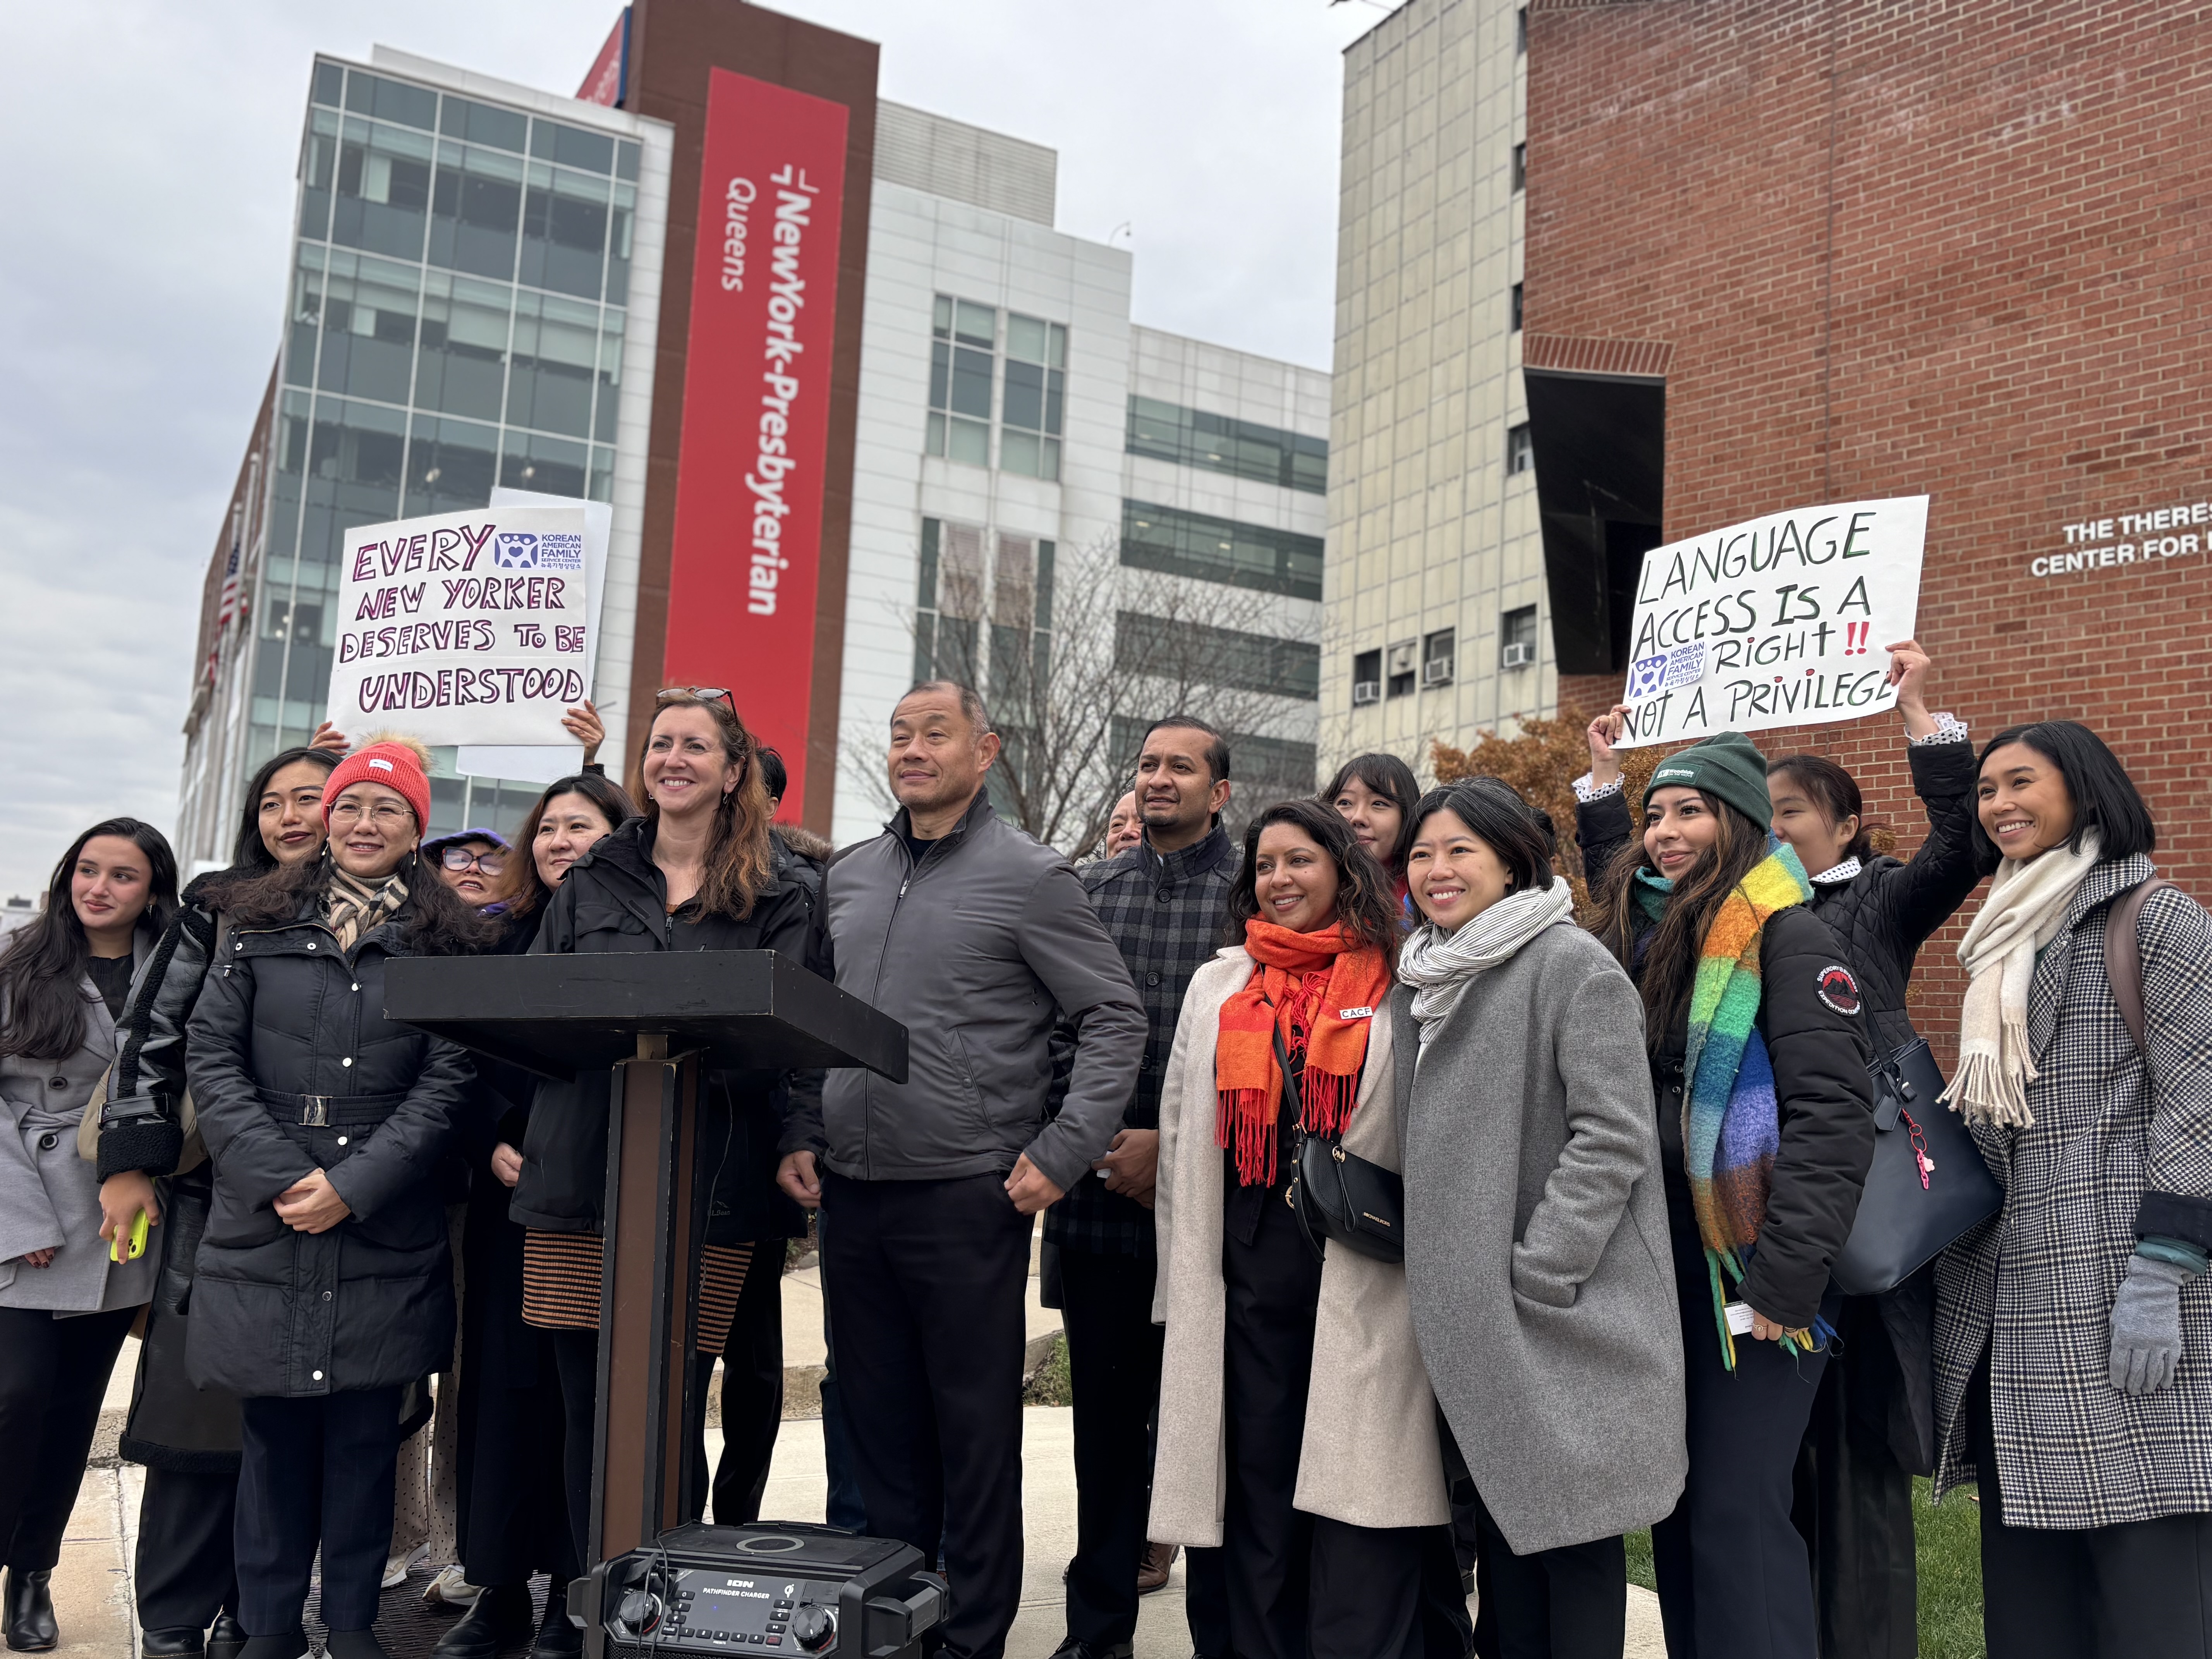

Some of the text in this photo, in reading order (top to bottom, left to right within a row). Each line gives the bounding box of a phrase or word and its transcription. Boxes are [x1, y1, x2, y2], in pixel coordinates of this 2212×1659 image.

[721, 177, 756, 291] Queens
[2063, 502, 2212, 543] THE THERE
[352, 524, 496, 582] EVERY
[541, 549, 581, 558] FAMILY
[1639, 512, 1876, 605] LANGUAGE
[2031, 544, 2135, 577] CENTER
[2143, 534, 2198, 560] FOR
[355, 577, 565, 621] NEW YORKER
[1632, 575, 1872, 663] ACCESS IS A
[339, 620, 495, 663] DESERVES
[556, 625, 586, 653] BE
[1670, 651, 1704, 666] AMERICAN
[1671, 642, 1704, 659] KOREAN
[1668, 658, 1703, 676] FAMILY
[359, 668, 584, 713] UNDERSTOOD
[1683, 686, 1707, 729] A
[1342, 1008, 1371, 1018] CACF
[703, 1588, 740, 1596] PATHFINDER
[727, 1580, 754, 1588] ION
